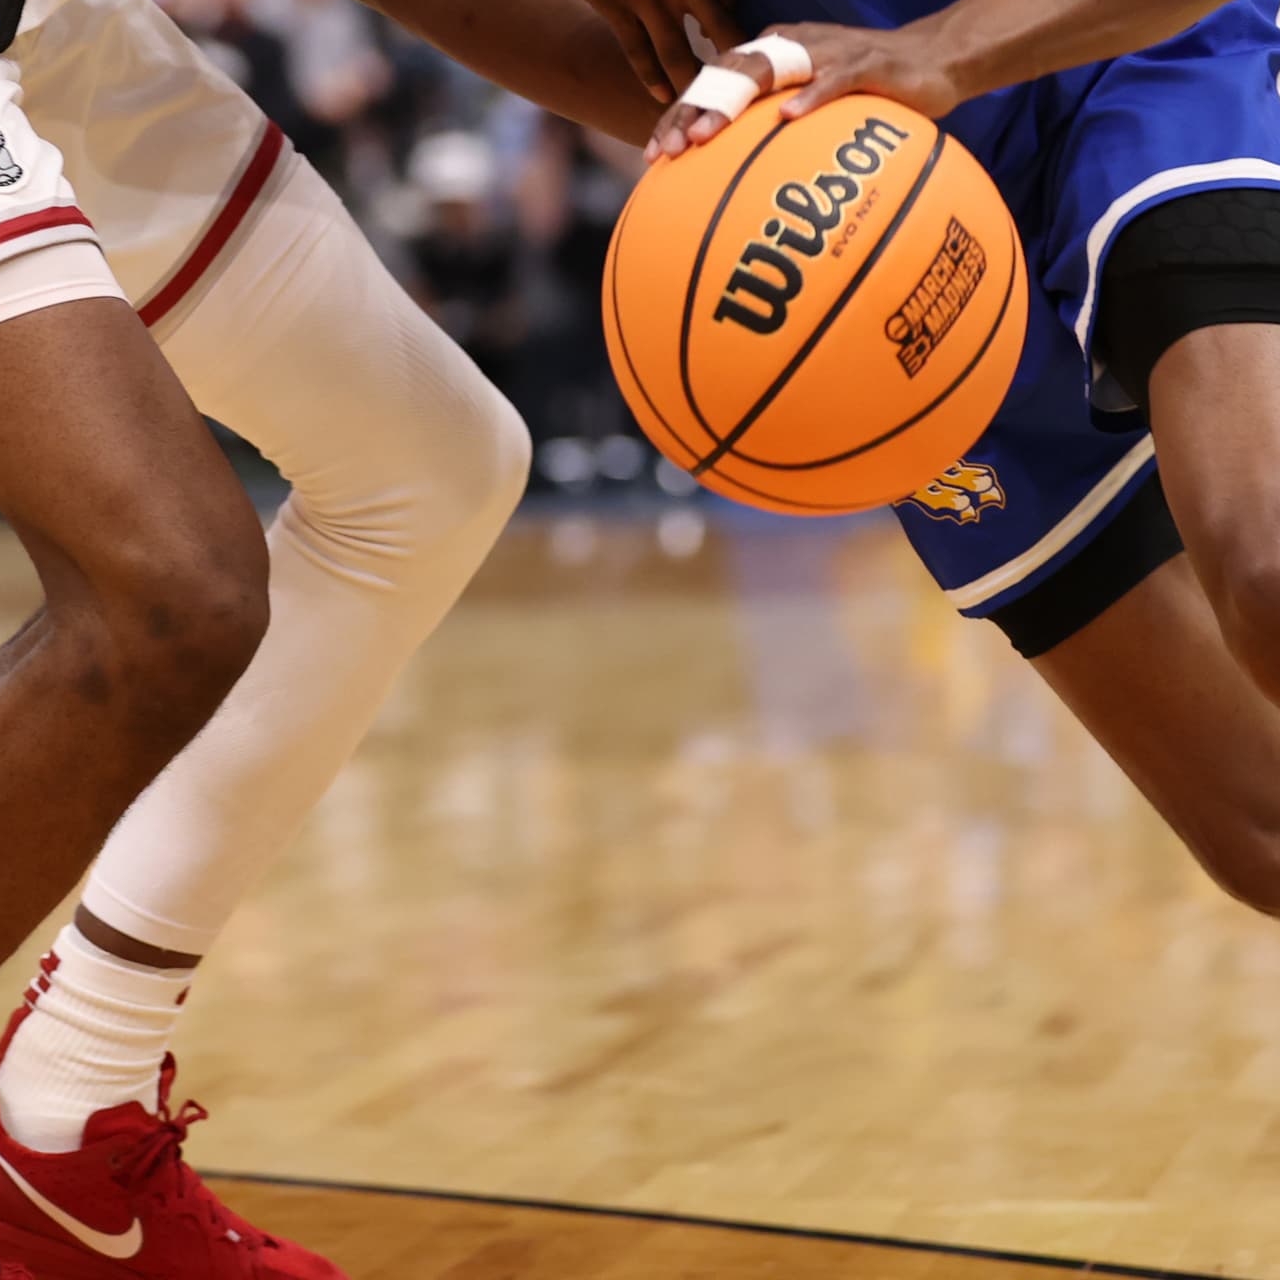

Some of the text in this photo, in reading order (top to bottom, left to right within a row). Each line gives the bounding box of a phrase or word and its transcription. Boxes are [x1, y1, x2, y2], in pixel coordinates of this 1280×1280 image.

[713, 117, 910, 336] Wilson
[831, 222, 858, 258] EVO
[901, 251, 957, 340] MARCH
[924, 237, 987, 347] MADNESS
